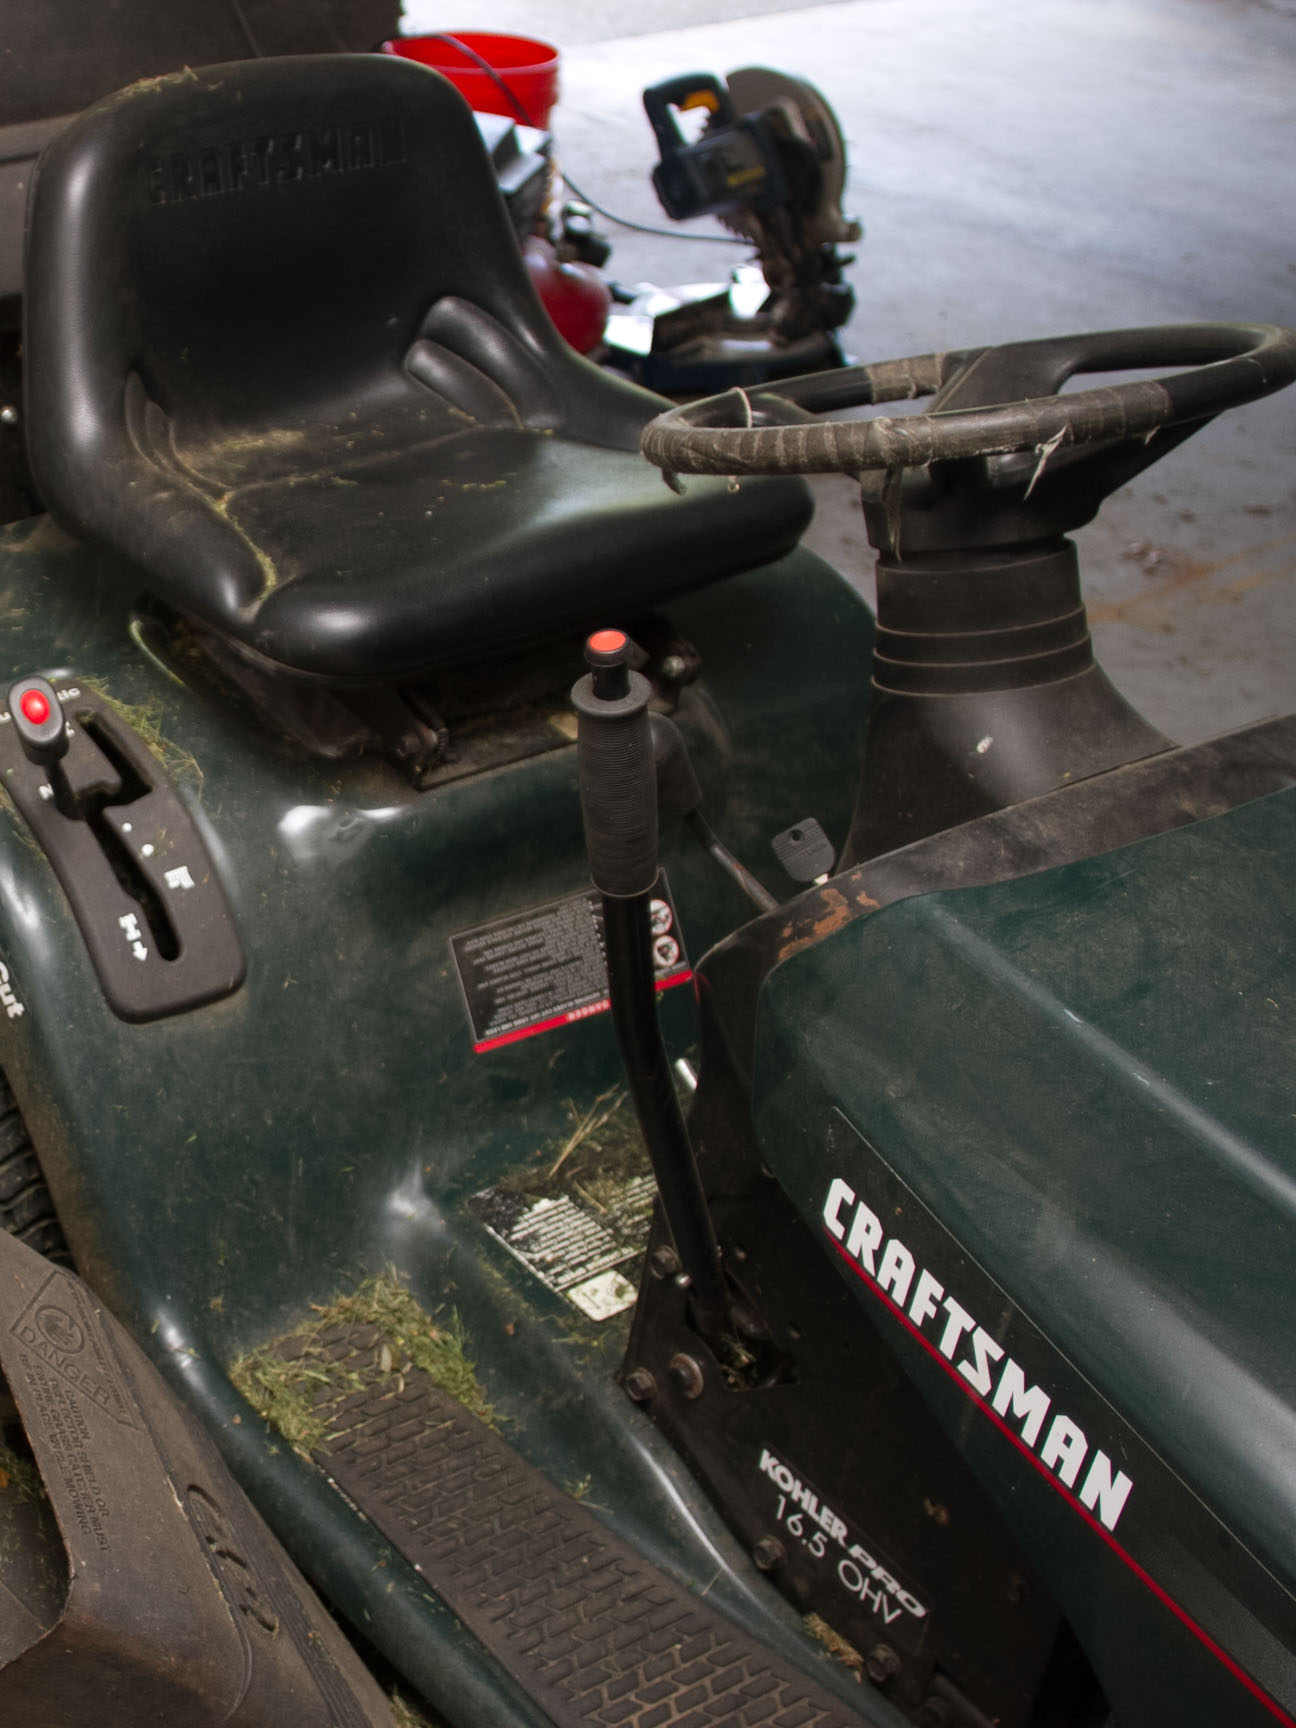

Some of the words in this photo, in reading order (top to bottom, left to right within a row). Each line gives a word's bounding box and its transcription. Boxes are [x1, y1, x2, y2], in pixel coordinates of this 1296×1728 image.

[19, 1326, 111, 1405] DANGER
[823, 1178, 1133, 1532] CRAFTSMAN
[64, 1478, 92, 1535] MOWING
[759, 1448, 848, 1547] KOHLER
[848, 1544, 927, 1618] PRO
[776, 1494, 829, 1558] 16.5
[838, 1559, 902, 1624] OHV
